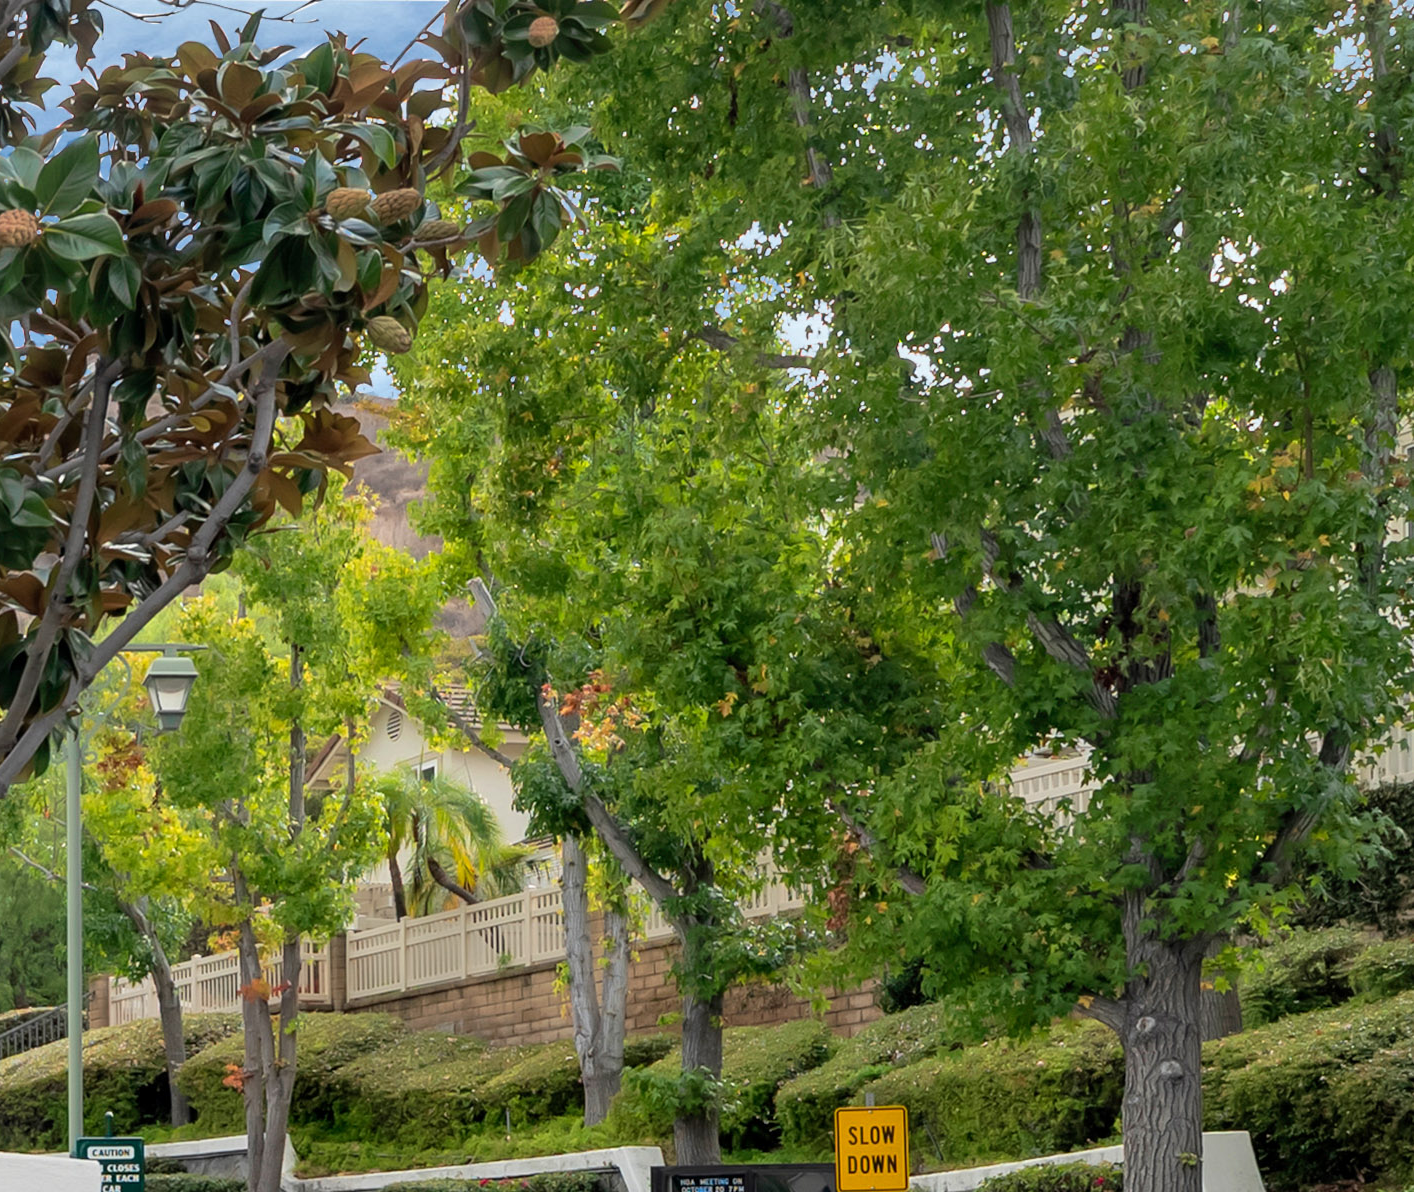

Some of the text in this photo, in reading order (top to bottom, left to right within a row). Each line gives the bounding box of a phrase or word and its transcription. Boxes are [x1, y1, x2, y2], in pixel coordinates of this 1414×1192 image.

[848, 1126, 895, 1145] SLOW
[92, 1149, 130, 1157] CAUTION
[107, 1163, 140, 1172] CLOSES
[848, 1154, 897, 1174] DOWN
[116, 1174, 140, 1182] EACH
[700, 1178, 729, 1186] MEETING
